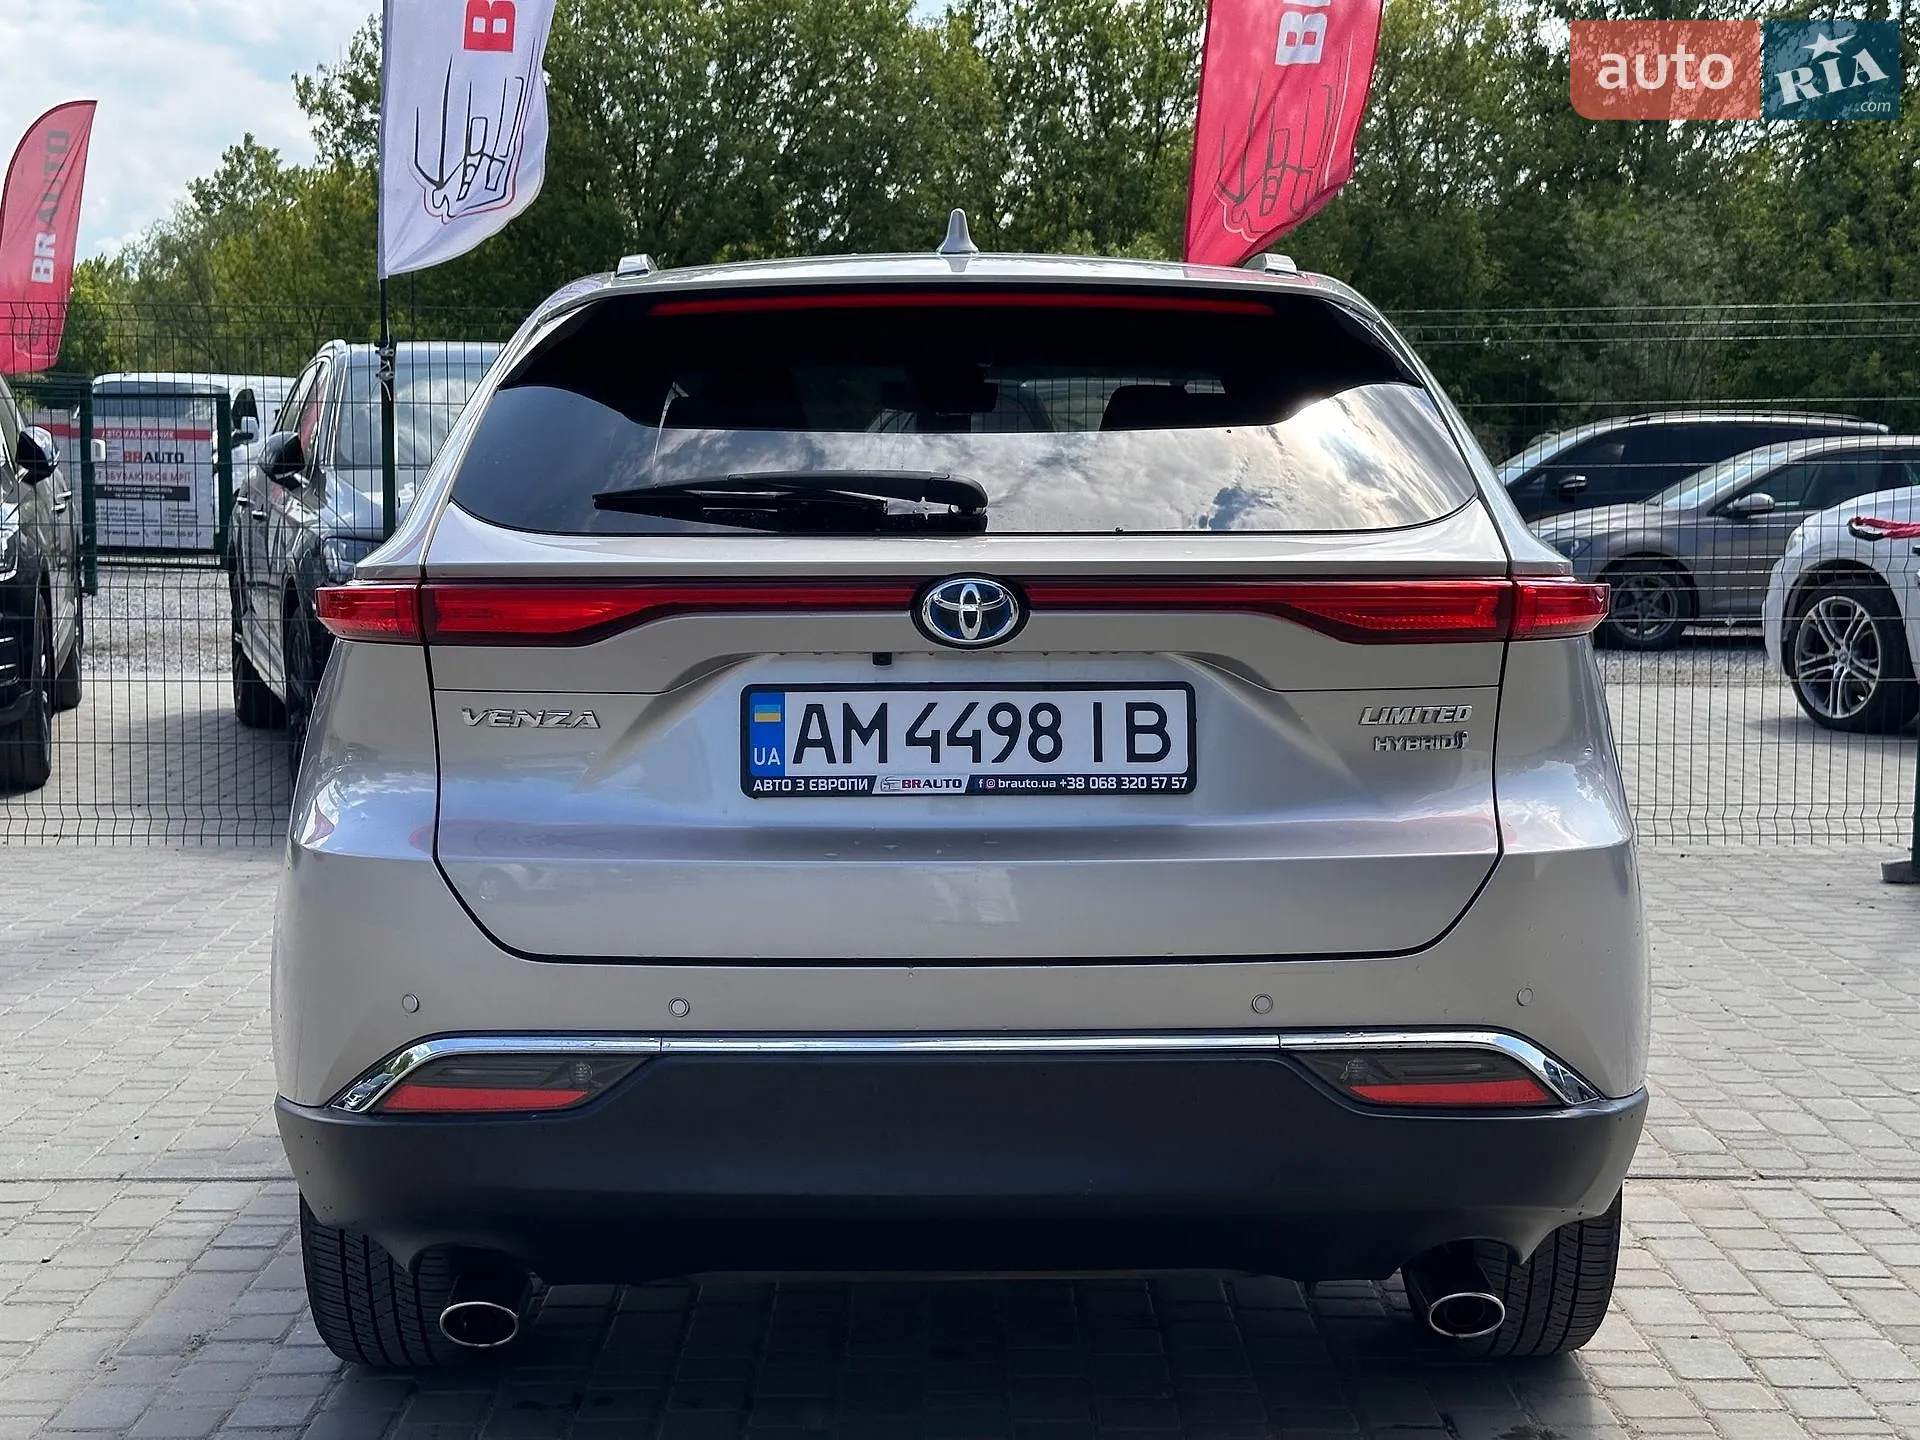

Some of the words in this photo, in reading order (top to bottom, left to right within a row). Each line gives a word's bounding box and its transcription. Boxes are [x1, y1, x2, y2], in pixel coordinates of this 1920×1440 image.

[1275, 0, 1331, 66] B
[31, 129, 70, 284] BRAUTO
[123, 451, 185, 463] BRAUTO
[461, 707, 600, 728] VENZA
[1359, 704, 1473, 725] LIMITED
[793, 702, 888, 765] AM
[905, 701, 1063, 764] 4498
[753, 747, 781, 766] UA
[752, 779, 791, 792] АВТО
[901, 778, 963, 790] BRAUTO
[998, 778, 1057, 789] brauto.ua
[1059, 777, 1085, 789] +38
[1089, 777, 1117, 789] 068
[1121, 777, 1147, 789] 320
[1151, 777, 1169, 789] 57
[1171, 777, 1188, 789] 57
